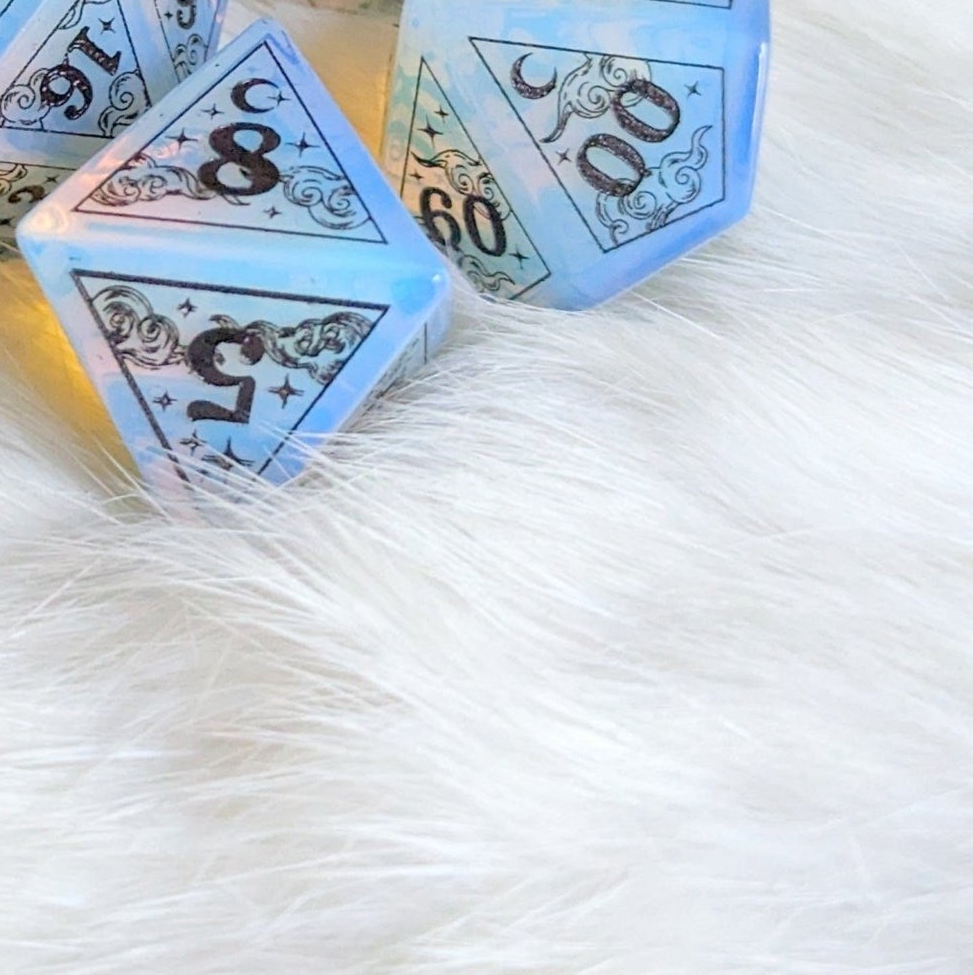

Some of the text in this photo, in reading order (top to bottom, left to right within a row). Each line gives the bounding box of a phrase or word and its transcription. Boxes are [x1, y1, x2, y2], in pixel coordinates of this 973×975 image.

[39, 27, 121, 120] 16
[199, 122, 281, 196] 8
[576, 78, 680, 197] 00
[420, 186, 506, 257] 60
[186, 327, 266, 424] 5
